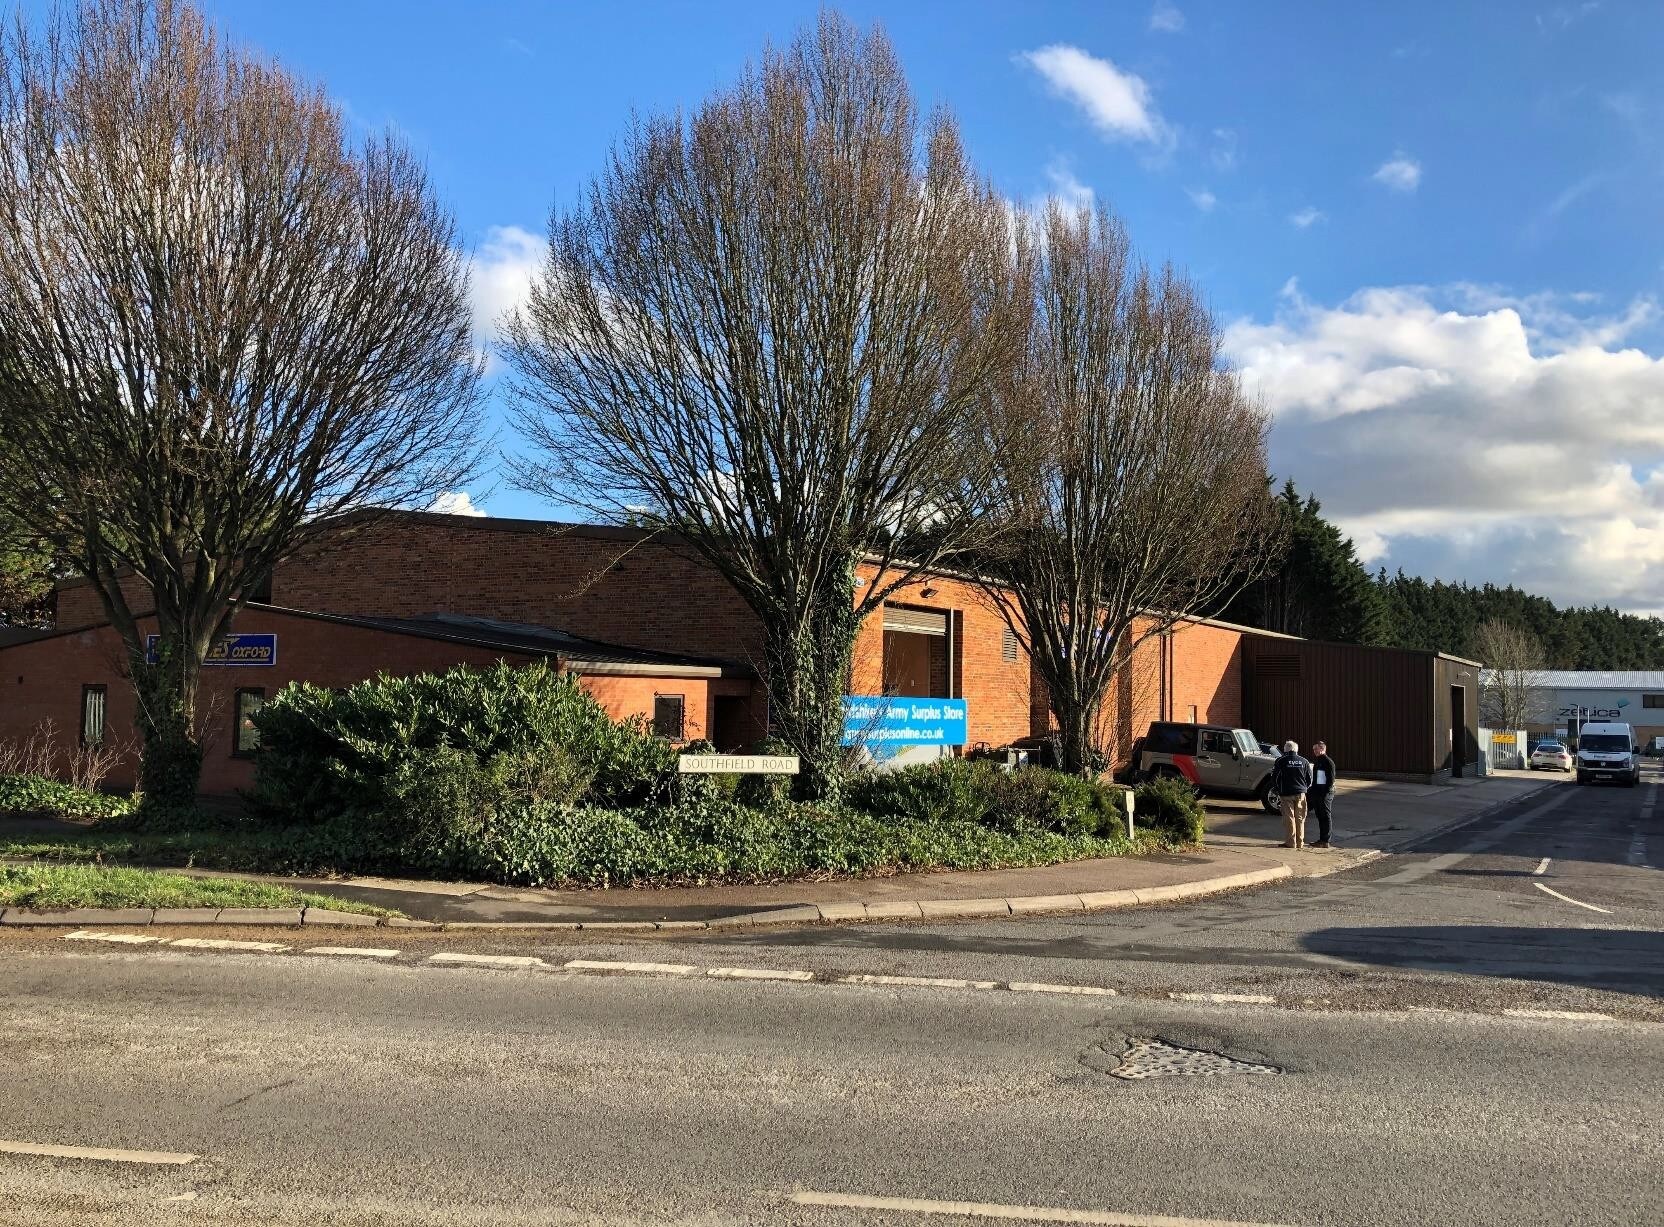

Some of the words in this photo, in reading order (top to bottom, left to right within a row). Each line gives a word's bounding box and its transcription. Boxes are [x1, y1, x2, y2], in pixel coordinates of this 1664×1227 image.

[886, 705, 909, 722] Army
[911, 704, 941, 723] Surplus
[943, 705, 964, 720] Store
[685, 758, 755, 769] SOUTHFIELD
[762, 759, 793, 770] ROAD
